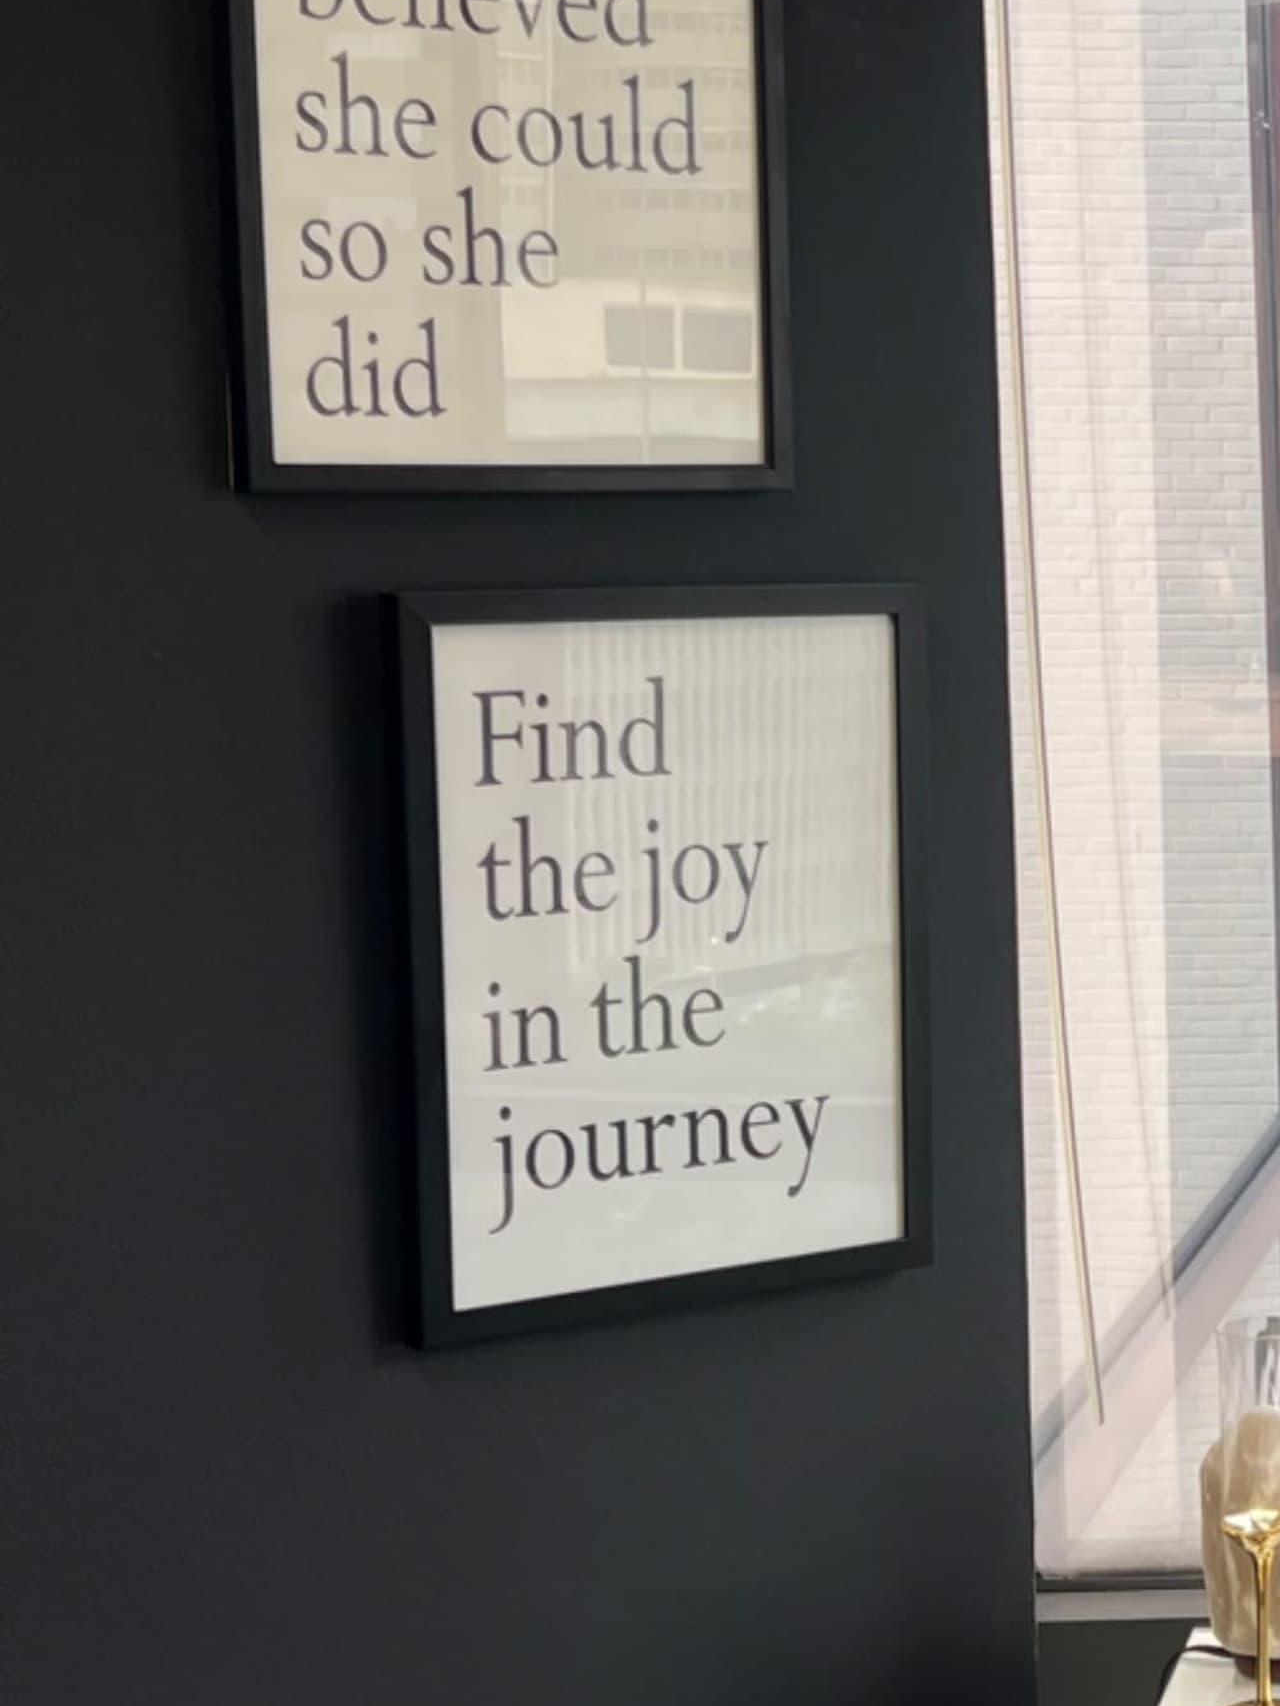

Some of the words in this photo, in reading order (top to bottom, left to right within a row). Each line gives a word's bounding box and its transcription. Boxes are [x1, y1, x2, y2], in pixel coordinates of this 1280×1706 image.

[295, 51, 438, 160] she
[470, 75, 704, 177] could
[300, 213, 389, 283] so
[421, 185, 560, 289] she
[305, 315, 448, 419] did
[471, 676, 672, 788] Find
[476, 813, 617, 923] the
[636, 818, 770, 944] joy
[482, 981, 568, 1073] in
[589, 954, 727, 1060] the
[487, 1094, 831, 1235] journey
